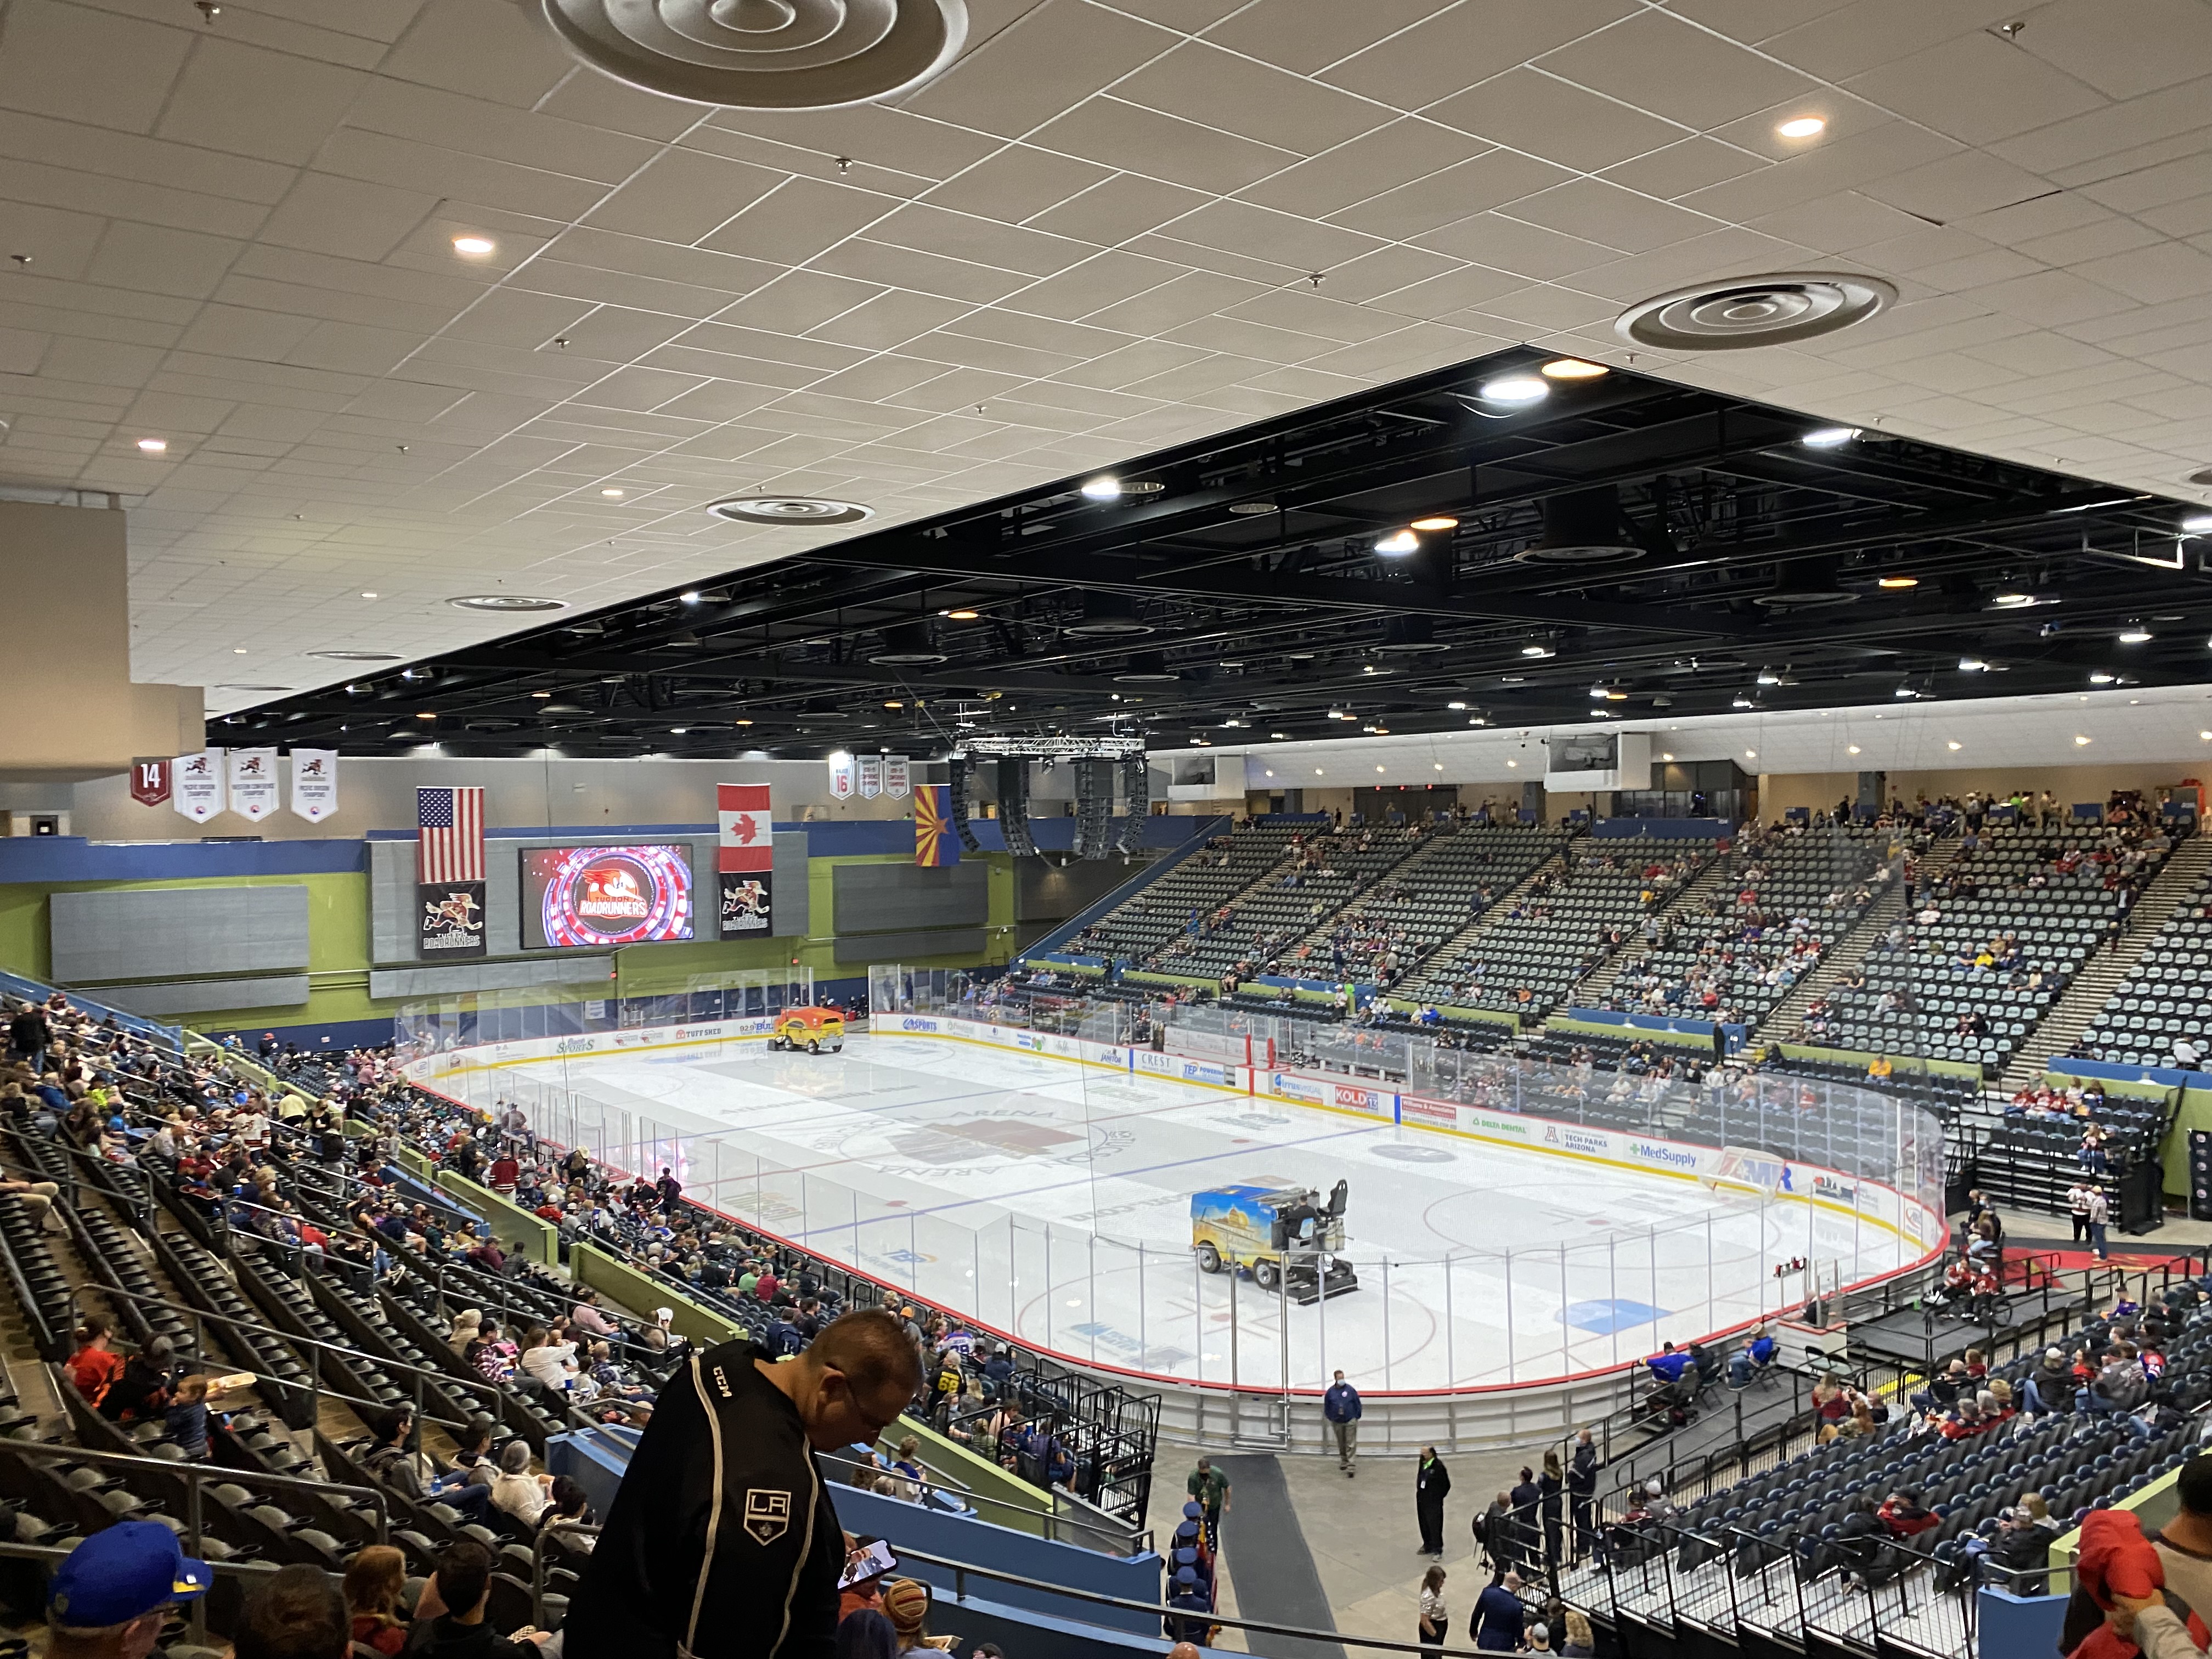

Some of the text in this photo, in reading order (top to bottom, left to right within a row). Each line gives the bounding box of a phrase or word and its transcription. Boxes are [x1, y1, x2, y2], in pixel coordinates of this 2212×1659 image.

[141, 764, 161, 788] 14
[837, 775, 847, 792] 16
[580, 901, 647, 916] ROADRUNNERS
[424, 935, 481, 949] ROADRUNNERS
[915, 1020, 937, 1031] SPORTS
[1101, 1053, 1121, 1063] JANITOR
[1142, 1053, 1170, 1068] CREST
[1184, 1064, 1197, 1075] TEP
[1335, 1088, 1367, 1105] KOLD
[1369, 1098, 1378, 1110] 13
[948, 1109, 1054, 1118] ARENA
[1482, 1120, 1527, 1134] DELTA DENTAL
[1565, 1134, 1607, 1148] TECH PARKS
[1565, 1142, 1596, 1153] ARIZONA
[1640, 1144, 1696, 1168] MedSupply
[713, 1365, 732, 1397] CCM
[750, 1494, 787, 1514] LA
